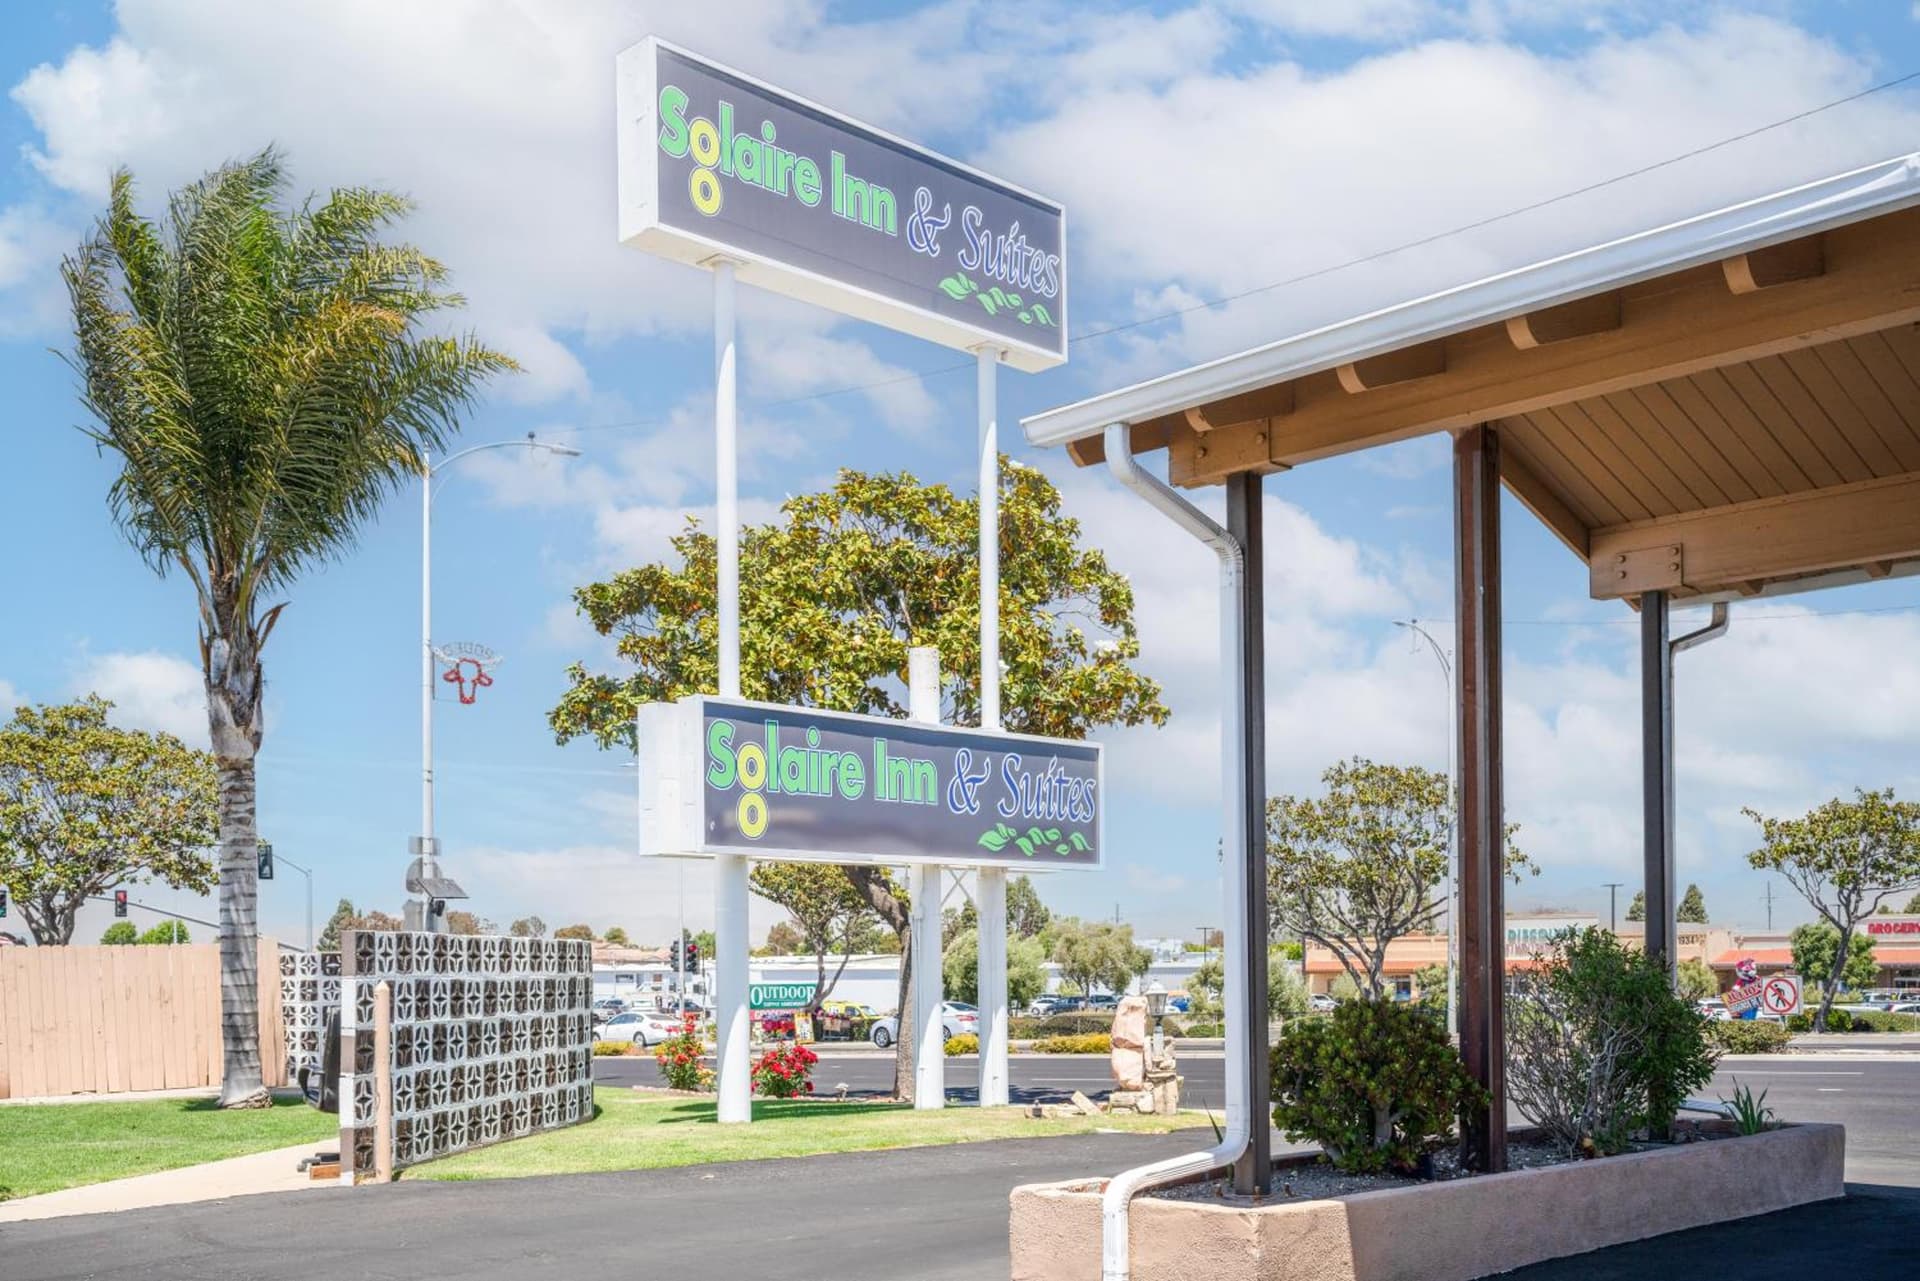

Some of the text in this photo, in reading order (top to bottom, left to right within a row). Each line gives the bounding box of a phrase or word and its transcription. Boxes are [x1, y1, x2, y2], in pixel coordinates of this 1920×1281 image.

[658, 84, 822, 208] Solaire
[831, 149, 898, 238] Inn
[906, 186, 952, 258] &
[705, 718, 866, 801] Solaire
[873, 736, 939, 806] Inn
[947, 747, 992, 816] &
[750, 986, 816, 1006] OUTDOOR
